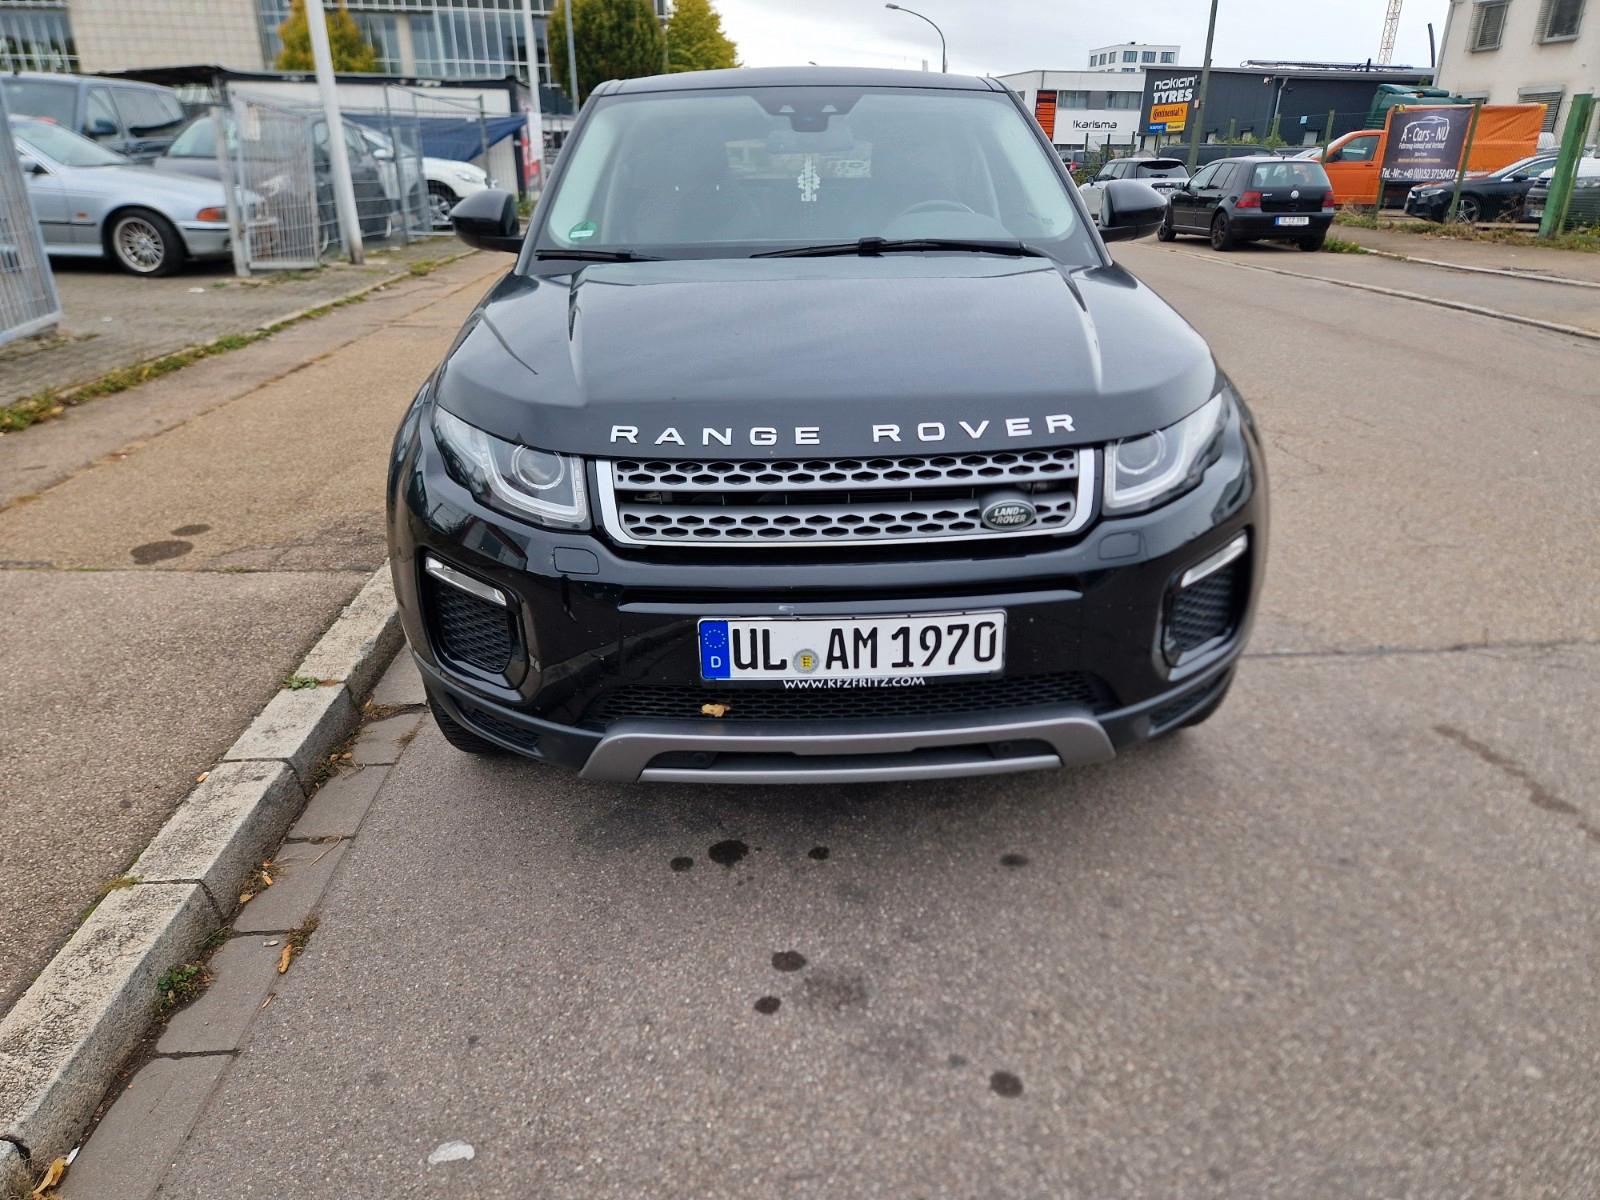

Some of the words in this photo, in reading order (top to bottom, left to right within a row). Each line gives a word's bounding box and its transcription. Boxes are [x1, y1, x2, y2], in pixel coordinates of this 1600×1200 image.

[1154, 77, 1196, 90] nokian
[1153, 88, 1193, 104] TYRES
[1401, 128, 1407, 141] A
[1412, 127, 1430, 141] Cars
[1435, 127, 1450, 141] NU
[609, 424, 821, 447] RANGE
[872, 414, 1077, 443] ROVER
[994, 507, 1019, 516] LAND
[996, 515, 1027, 524] ROVER
[732, 627, 787, 670] UL
[825, 626, 878, 669] AM
[891, 621, 997, 668] 1970
[710, 656, 721, 668] D
[783, 676, 926, 689] WWW.KFZFRITZ.COM
